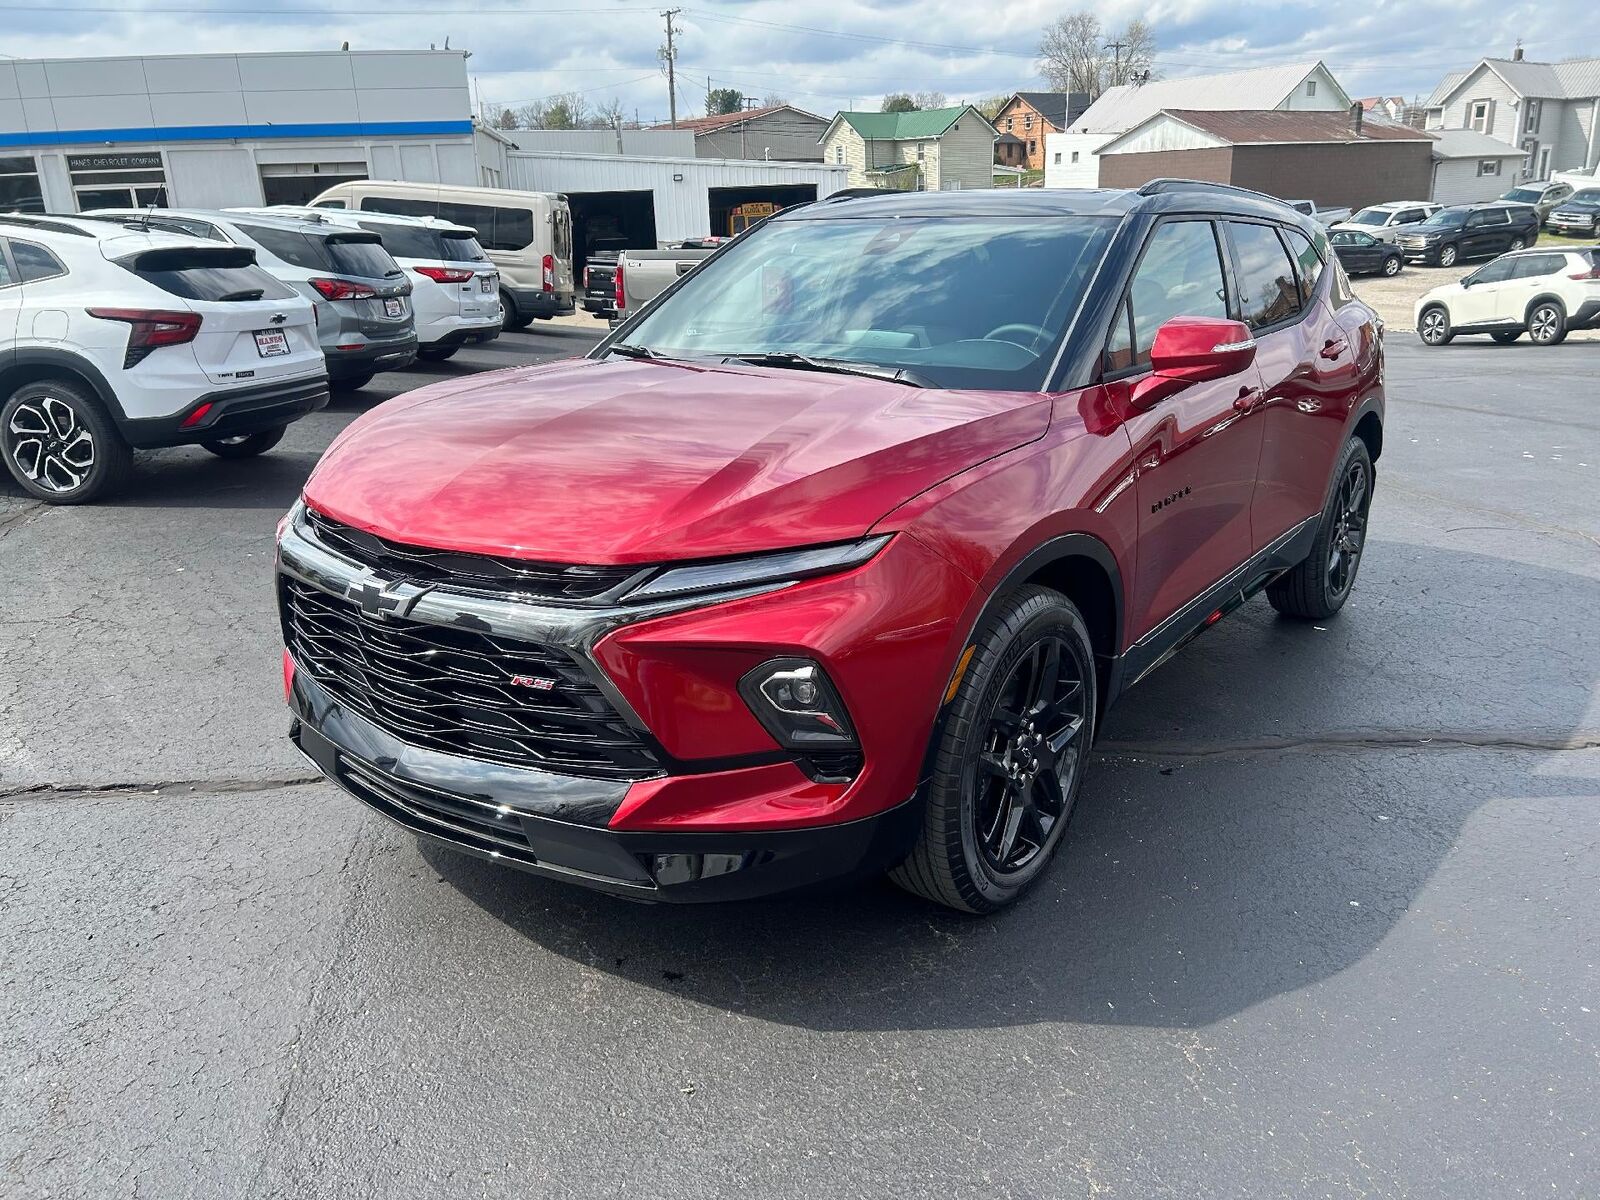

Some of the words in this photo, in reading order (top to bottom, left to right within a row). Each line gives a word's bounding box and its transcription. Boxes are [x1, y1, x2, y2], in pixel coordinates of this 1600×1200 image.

[71, 158, 91, 167] HANES
[93, 157, 128, 167] CHEVROLET
[131, 157, 160, 166] COMPANY
[258, 335, 283, 345] HANES
[510, 675, 555, 691] RS
